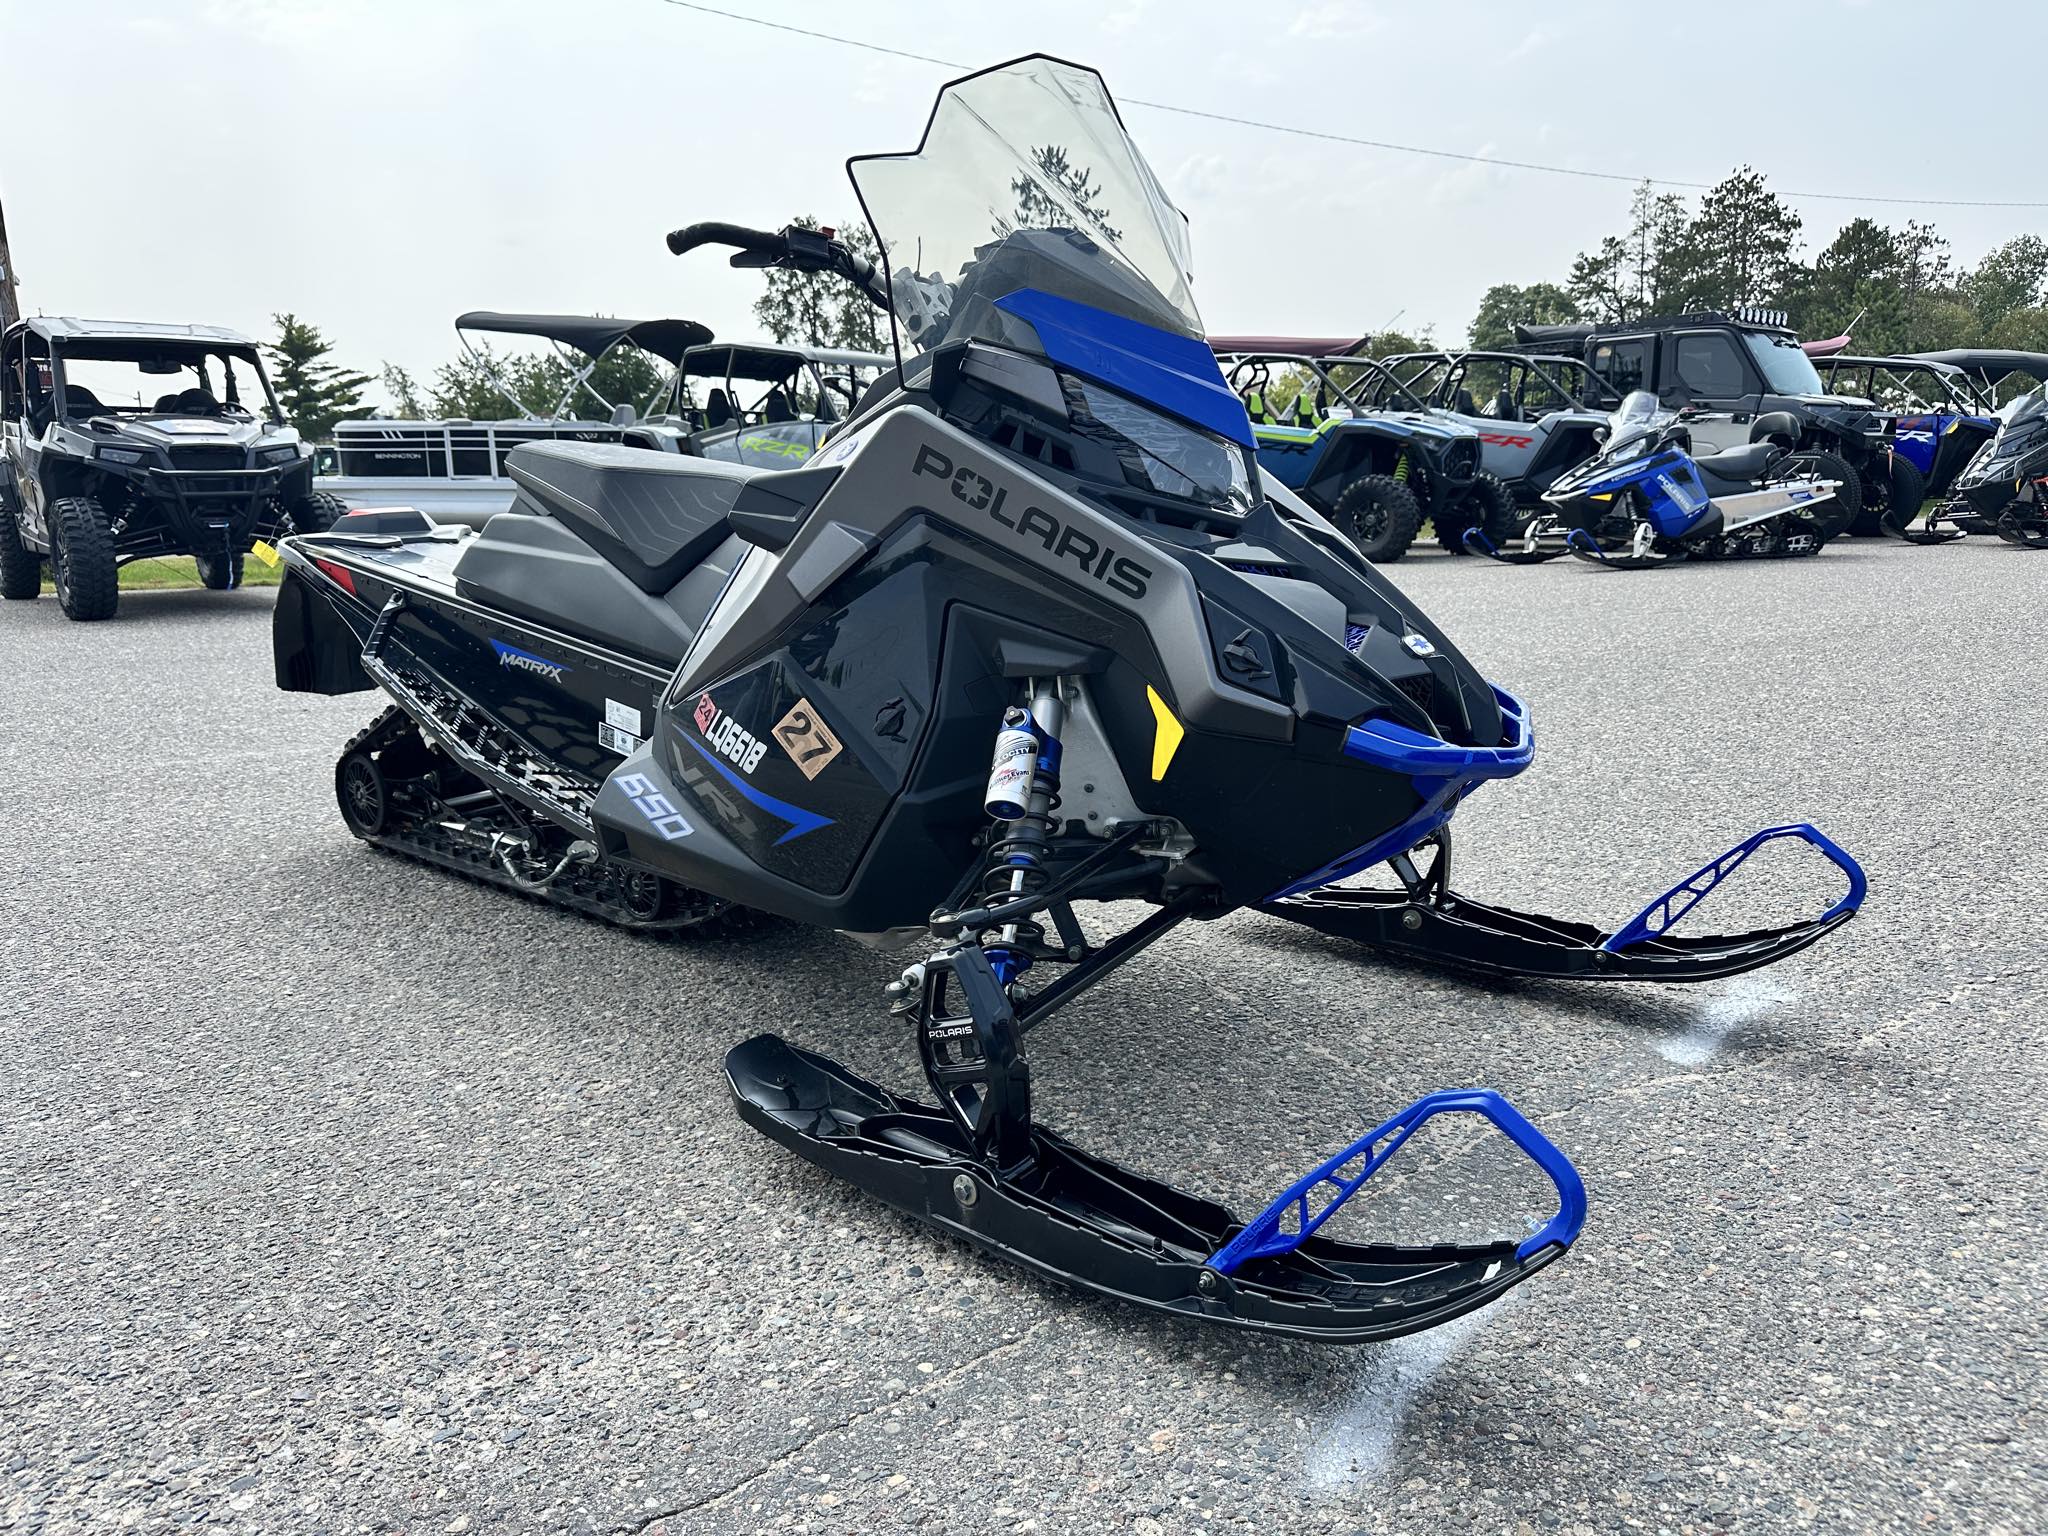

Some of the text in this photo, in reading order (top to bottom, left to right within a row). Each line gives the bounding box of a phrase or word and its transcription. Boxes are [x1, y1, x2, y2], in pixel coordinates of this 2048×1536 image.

[742, 436, 810, 461] RZR
[1478, 433, 1534, 449] ZR
[1657, 474, 1692, 510] POLARIS
[911, 443, 1153, 600] POLARIS
[500, 651, 562, 684] MATRYX
[699, 698, 712, 722] 24
[705, 709, 768, 775] LQ6618
[777, 711, 834, 764] 27
[613, 773, 695, 840] 650
[928, 1026, 973, 1039] POLARIS
[1231, 1207, 1279, 1254] POLARIS
